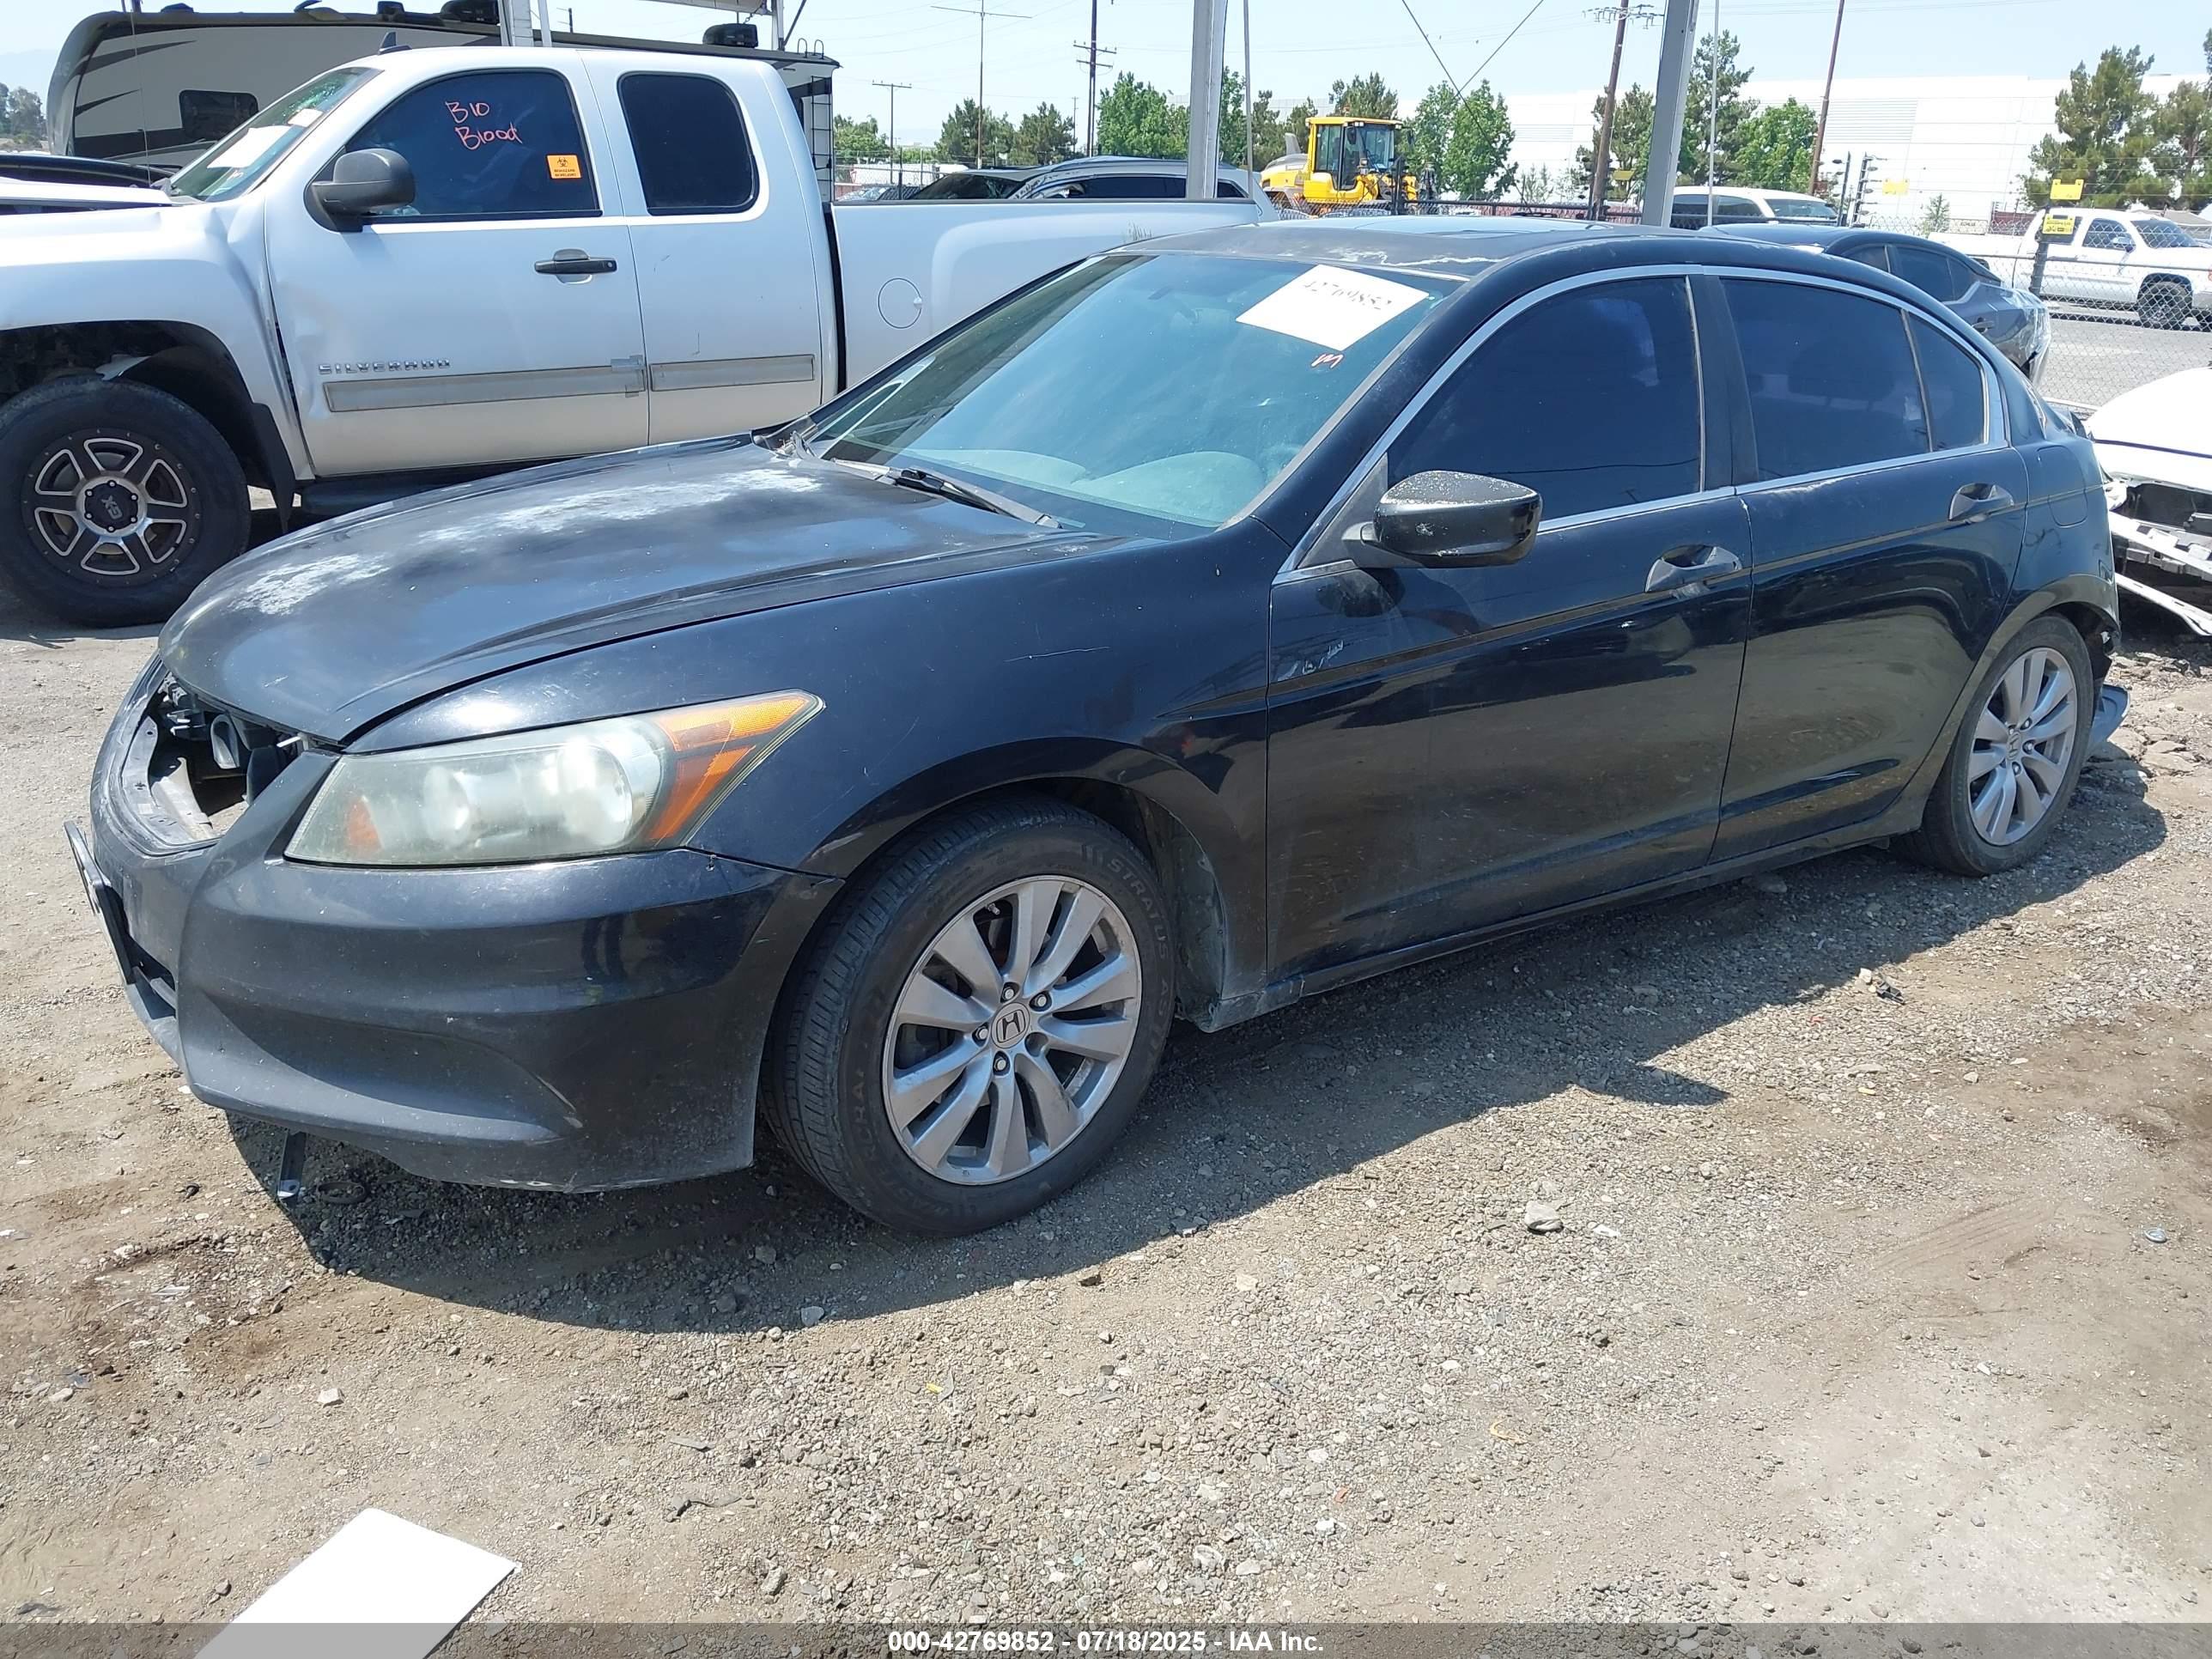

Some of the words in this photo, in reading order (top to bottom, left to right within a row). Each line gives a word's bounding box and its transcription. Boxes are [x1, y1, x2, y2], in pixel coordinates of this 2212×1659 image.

[455, 122, 523, 150] Blood
[319, 359, 450, 374] SILVERADO
[1108, 859, 1168, 959] STRATUS
